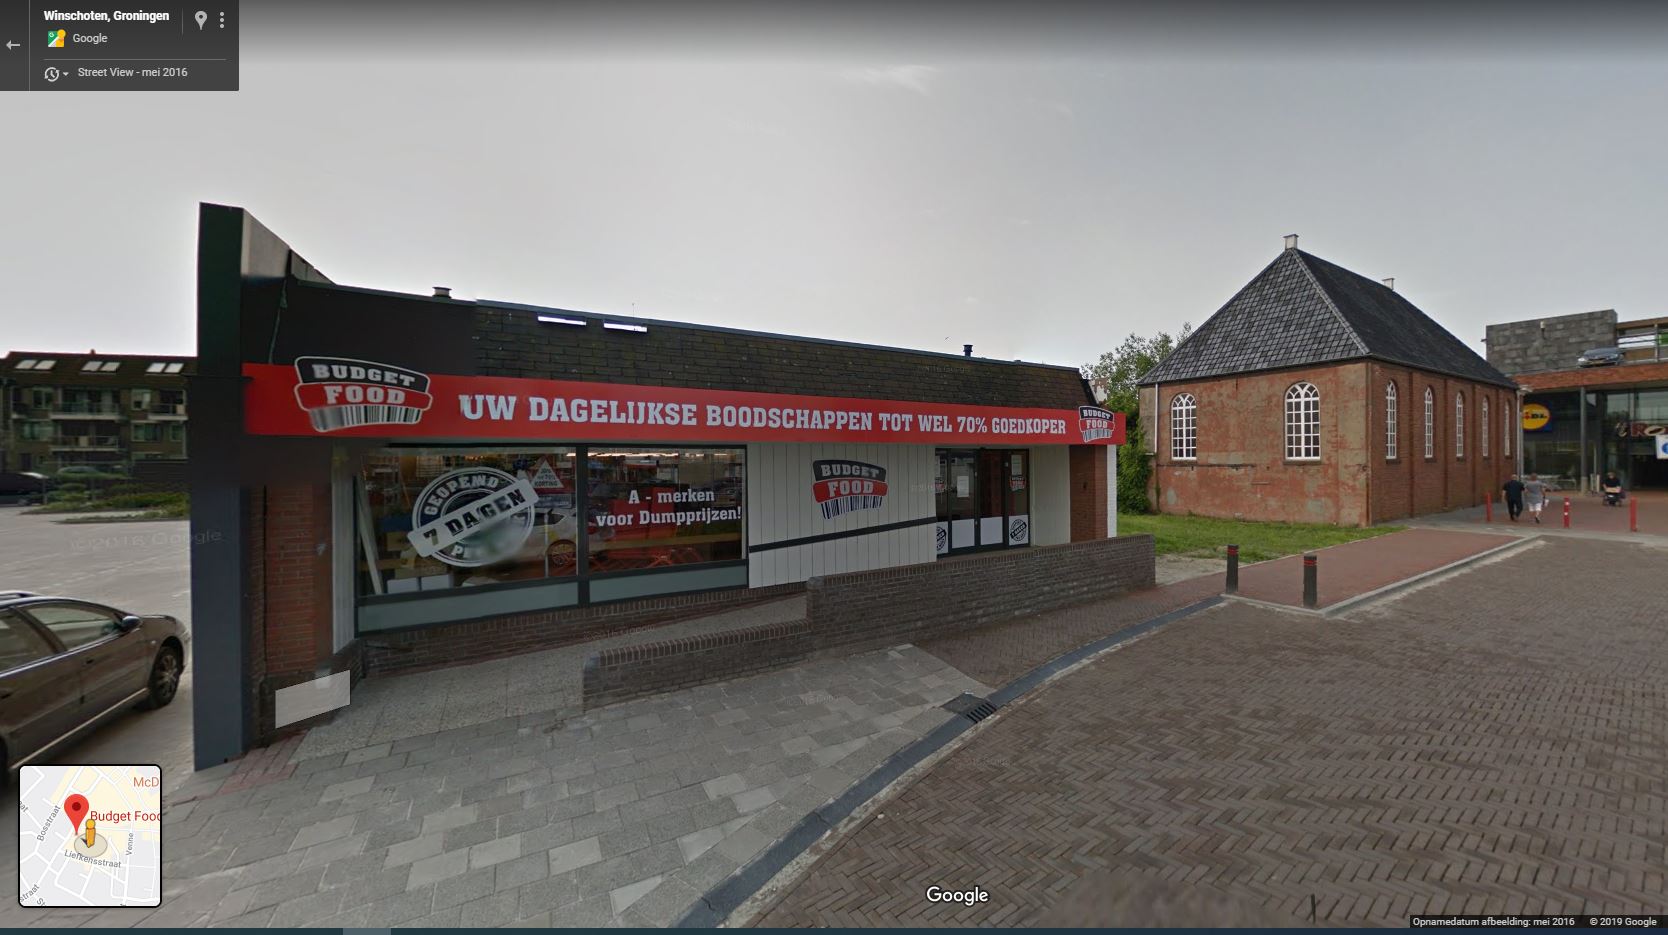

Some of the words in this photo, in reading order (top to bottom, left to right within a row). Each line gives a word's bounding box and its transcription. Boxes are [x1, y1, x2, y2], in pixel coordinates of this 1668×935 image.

[312, 364, 415, 386] BUDGET
[324, 385, 406, 405] FOOD
[459, 394, 517, 421] UW
[528, 396, 697, 426] DAGELIJKSE
[706, 404, 872, 431] BOODSCHAPPEN
[878, 412, 913, 431] TOT
[918, 414, 952, 433] WEL
[957, 417, 987, 433] 70%
[991, 417, 1066, 434] GOEDKOPER
[1083, 409, 1110, 420] BUDGET
[1086, 419, 1108, 429] FOOD
[820, 464, 880, 478] BUDGET
[423, 474, 500, 516] GEOPEND
[628, 489, 640, 505] A
[657, 488, 715, 504] merken
[827, 480, 874, 497] FOOD
[422, 528, 439, 546] 7
[444, 488, 527, 537] DAGEN
[595, 514, 634, 527] voor
[639, 506, 742, 526] Dumpprijzen!
